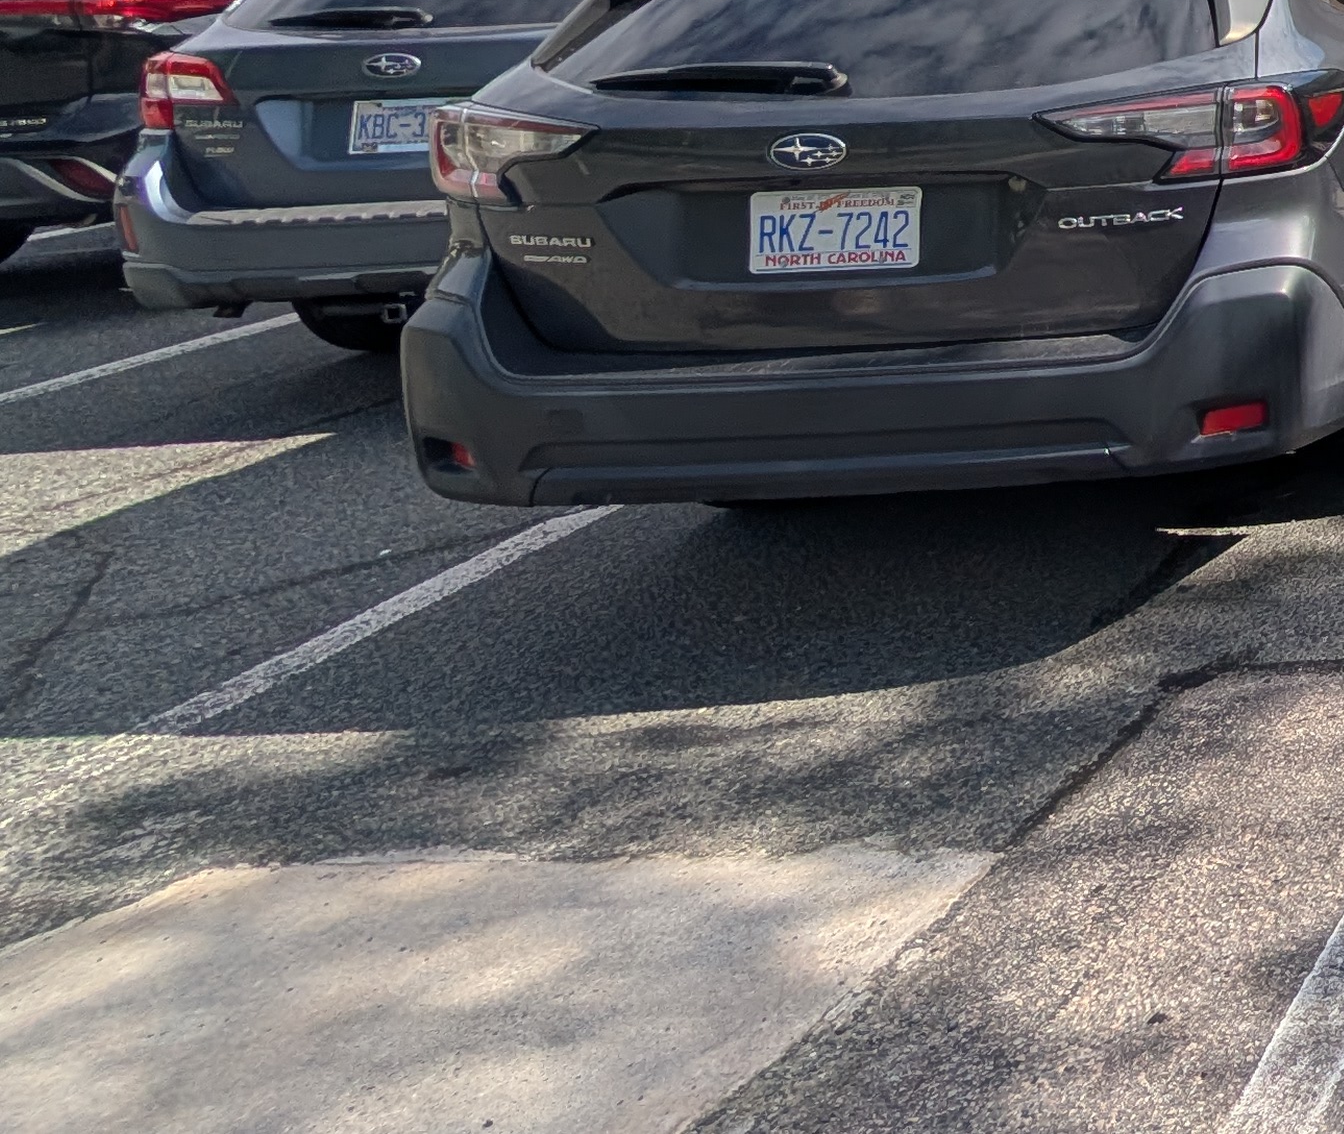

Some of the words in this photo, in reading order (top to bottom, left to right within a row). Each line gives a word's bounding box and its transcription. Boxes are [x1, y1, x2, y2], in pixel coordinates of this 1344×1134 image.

[358, 112, 429, 140] KBC-3
[780, 200, 816, 211] FIRST
[837, 197, 895, 208] FREEDOM
[1058, 207, 1184, 229] OUTBACK
[759, 210, 909, 253] RKZ-7242
[509, 234, 592, 247] SUBARU
[547, 255, 587, 264] AWD
[766, 254, 821, 266] NORTH
[828, 250, 906, 265] CAROLINA
